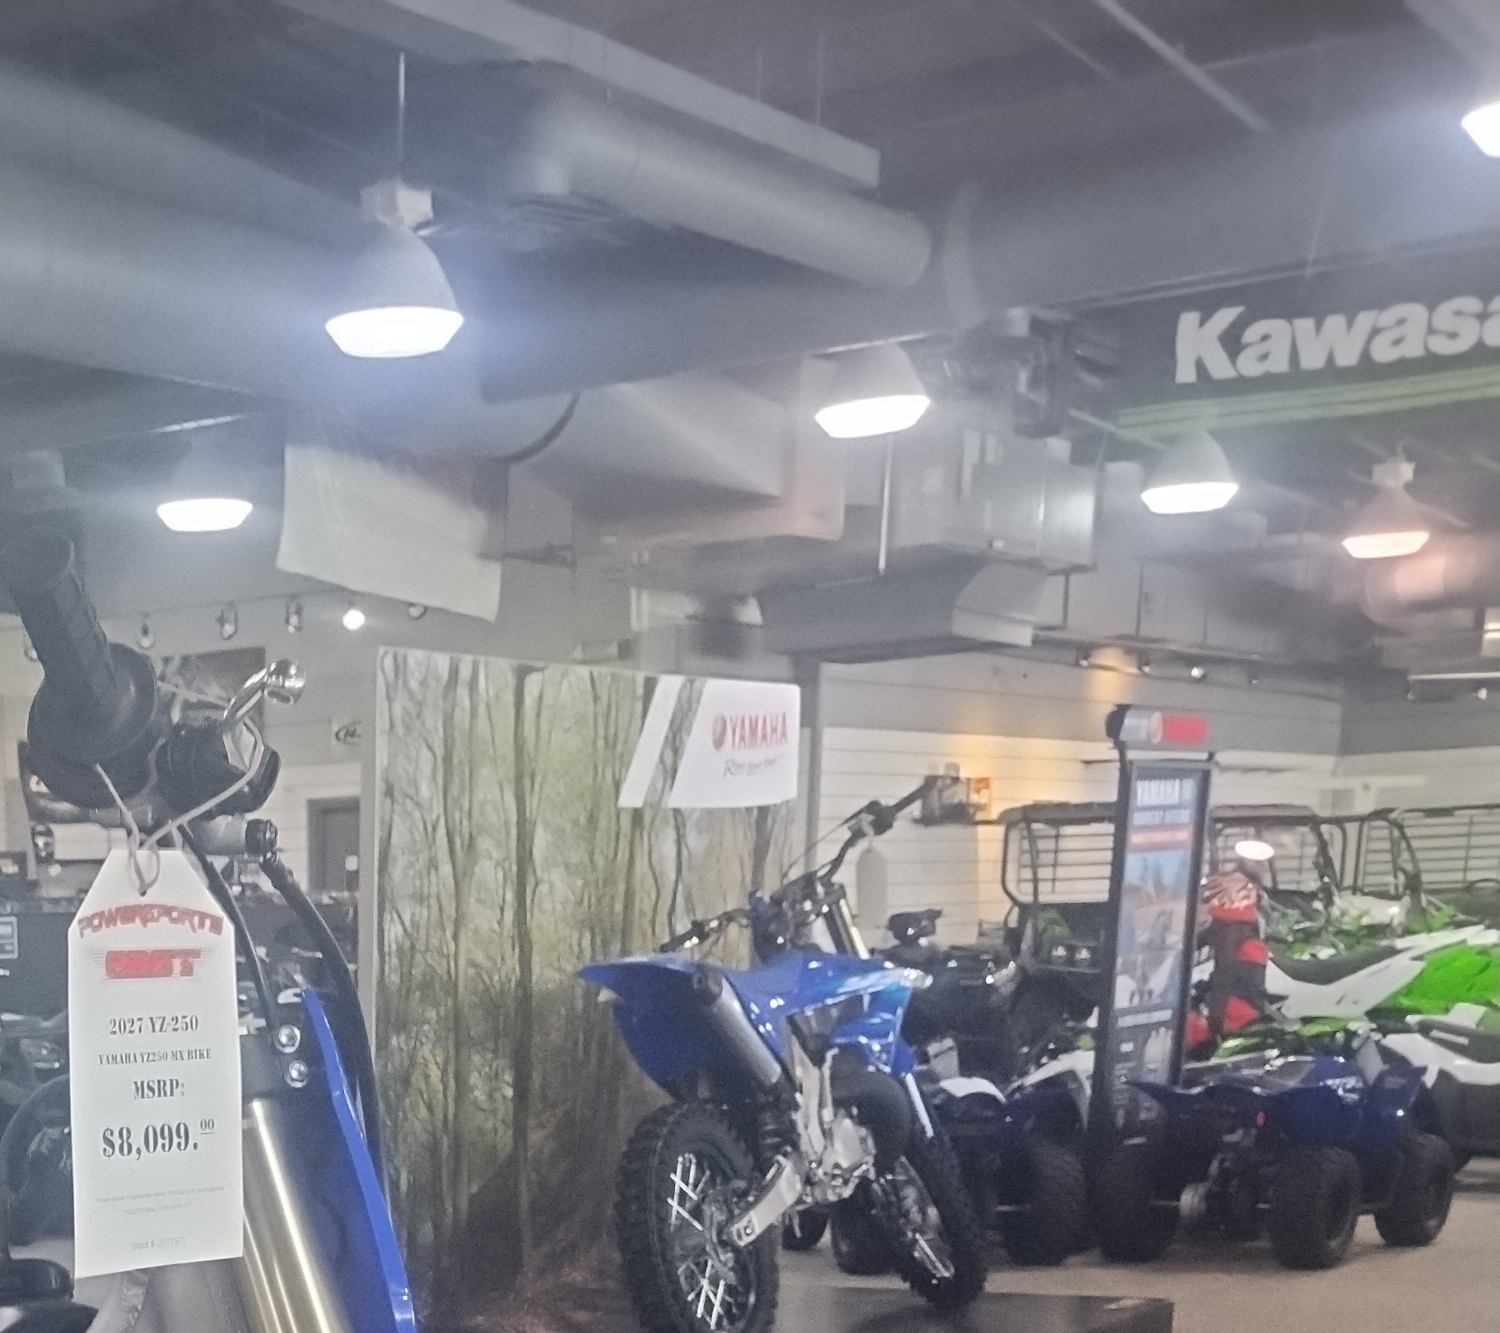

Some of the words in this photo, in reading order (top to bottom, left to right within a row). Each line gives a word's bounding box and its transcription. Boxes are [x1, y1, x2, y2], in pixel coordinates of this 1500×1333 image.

[728, 711, 788, 750] YAMAHA
[109, 1017, 144, 1036] 2027
[99, 1053, 138, 1066] YAMAHA
[140, 1051, 169, 1064] YZ250
[171, 1049, 185, 1062] MX
[187, 1048, 212, 1060] BIKE
[133, 1078, 185, 1100] MSRP:
